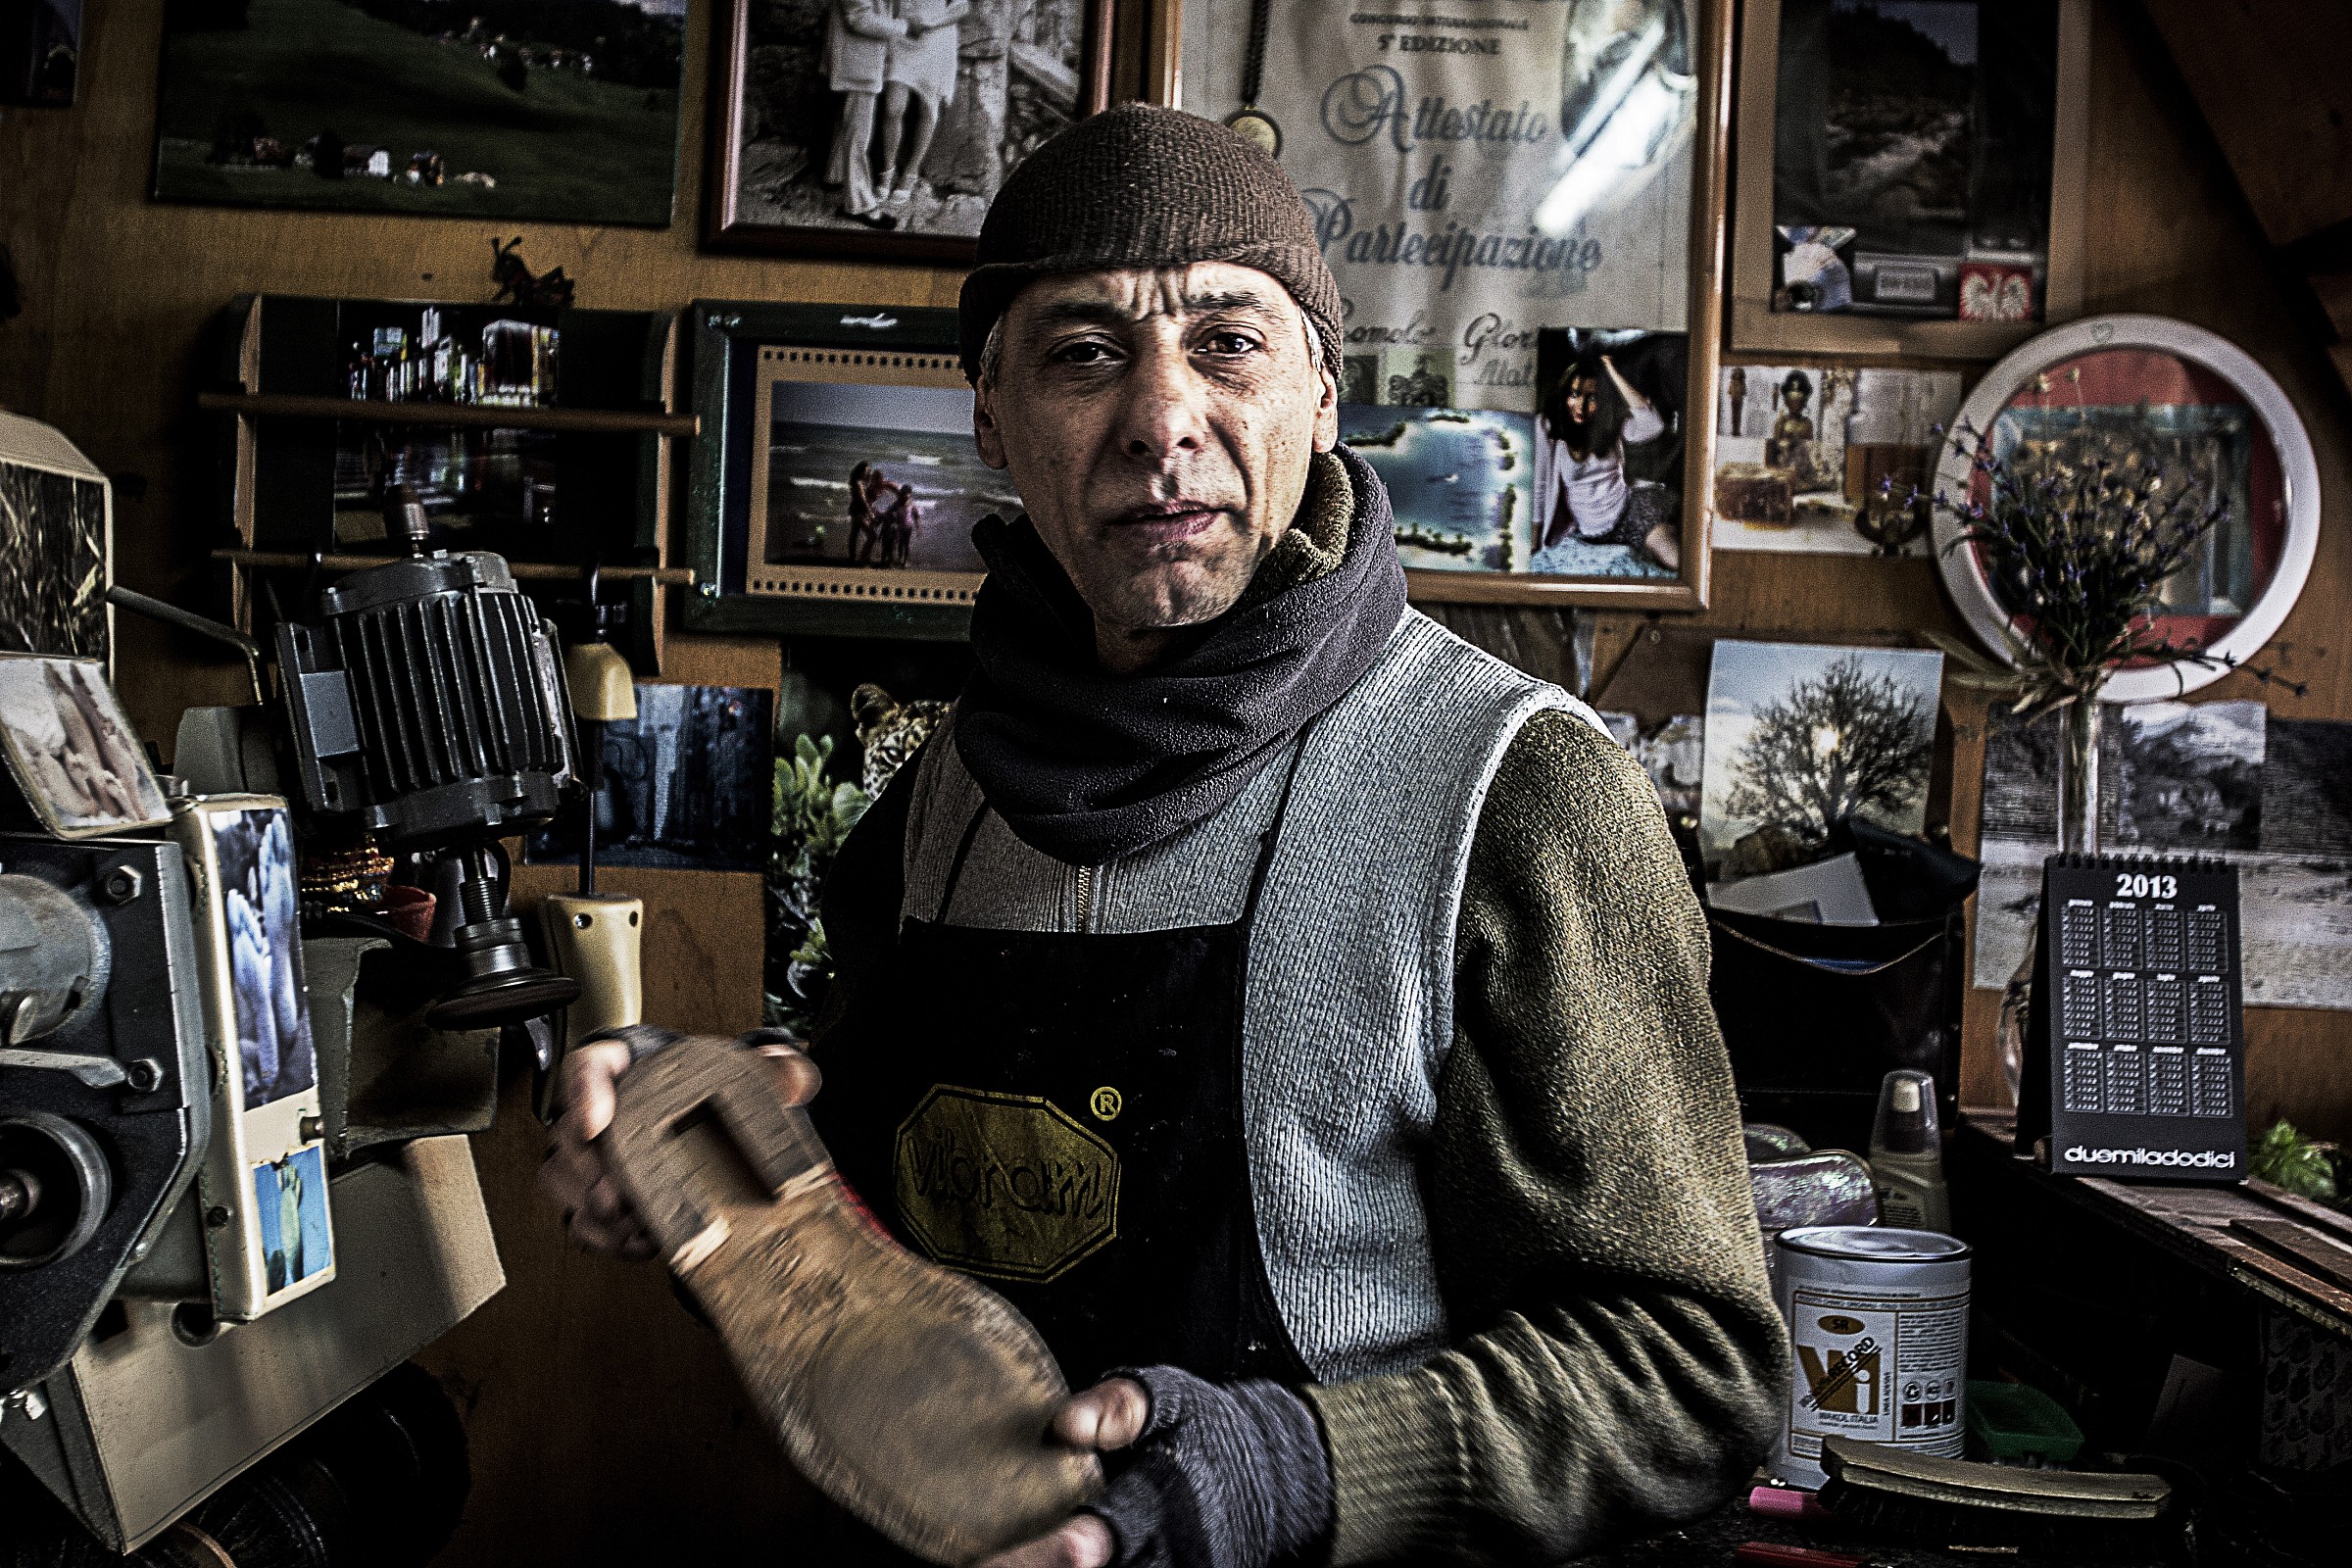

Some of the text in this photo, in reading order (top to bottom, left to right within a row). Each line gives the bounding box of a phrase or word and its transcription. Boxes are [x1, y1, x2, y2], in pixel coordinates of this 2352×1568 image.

[1399, 34, 1501, 55] EDIZIONE
[1320, 65, 1547, 153] Attestato
[1408, 154, 1452, 211] di
[1301, 188, 1602, 291] Partecipazione
[2116, 873, 2179, 899] 2013
[2064, 1145, 2235, 1169] duemiladodici
[1828, 1336, 1875, 1379] RECORD
